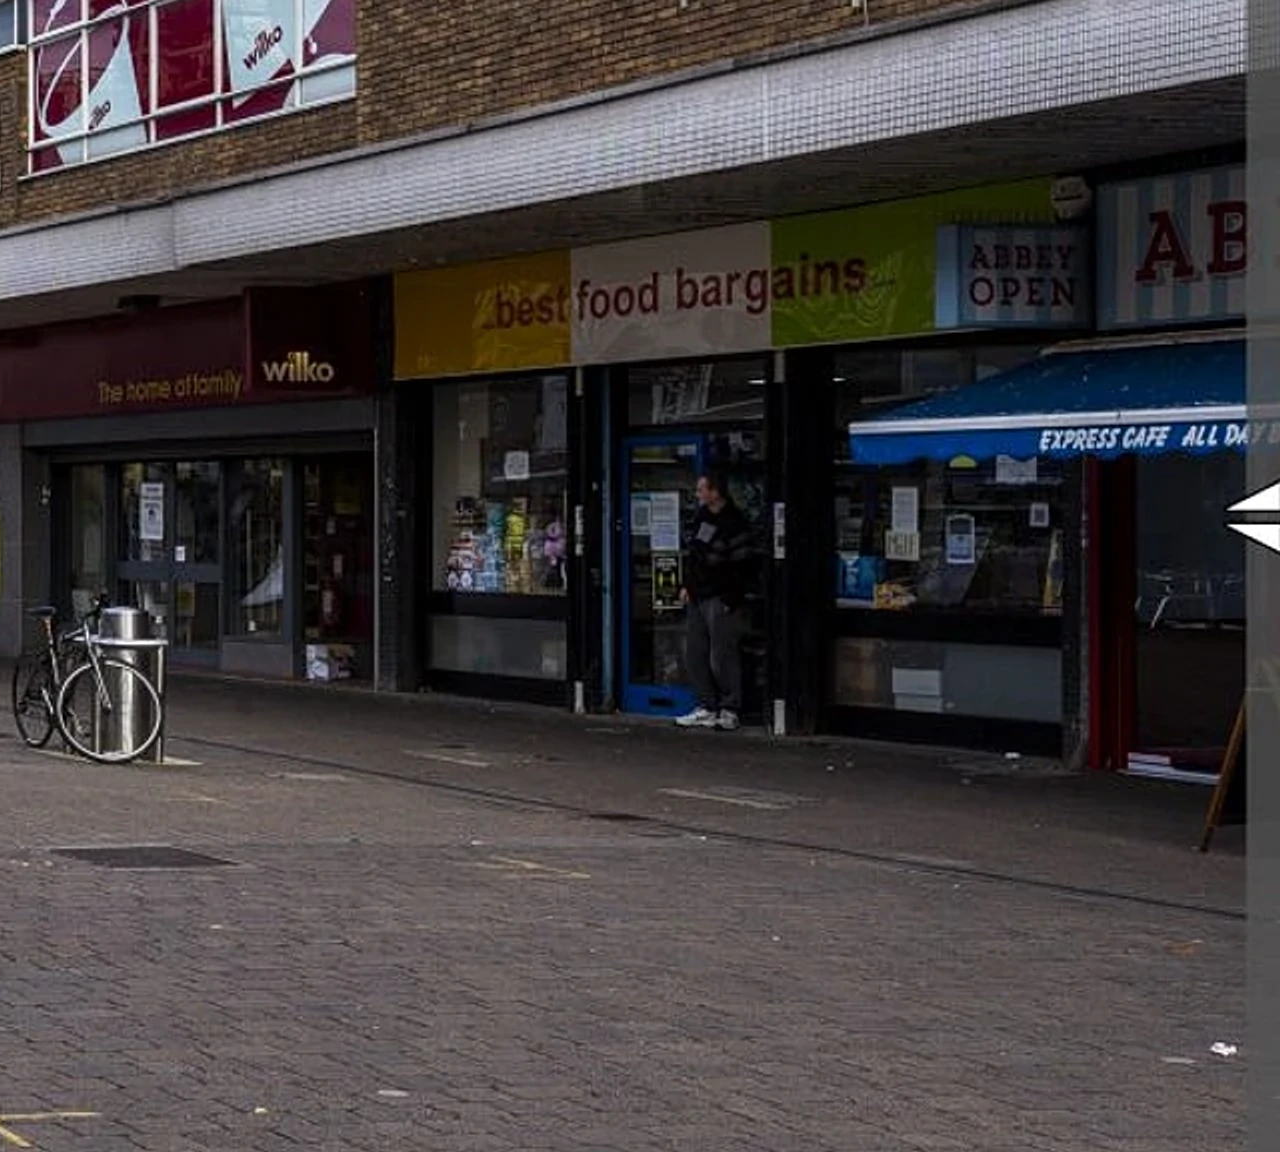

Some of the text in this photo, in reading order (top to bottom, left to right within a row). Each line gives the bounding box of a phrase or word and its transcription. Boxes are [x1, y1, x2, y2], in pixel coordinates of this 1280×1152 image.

[242, 24, 284, 70] wilko
[970, 243, 1076, 271] ABBEY
[576, 272, 660, 322] food
[676, 254, 868, 315] bargains
[969, 277, 1076, 307] OPEN
[262, 351, 335, 382] wilko
[97, 380, 123, 404] The
[1039, 426, 1121, 452] EXPRESS
[1122, 425, 1172, 449] CAFE
[1181, 424, 1219, 448] ALL
